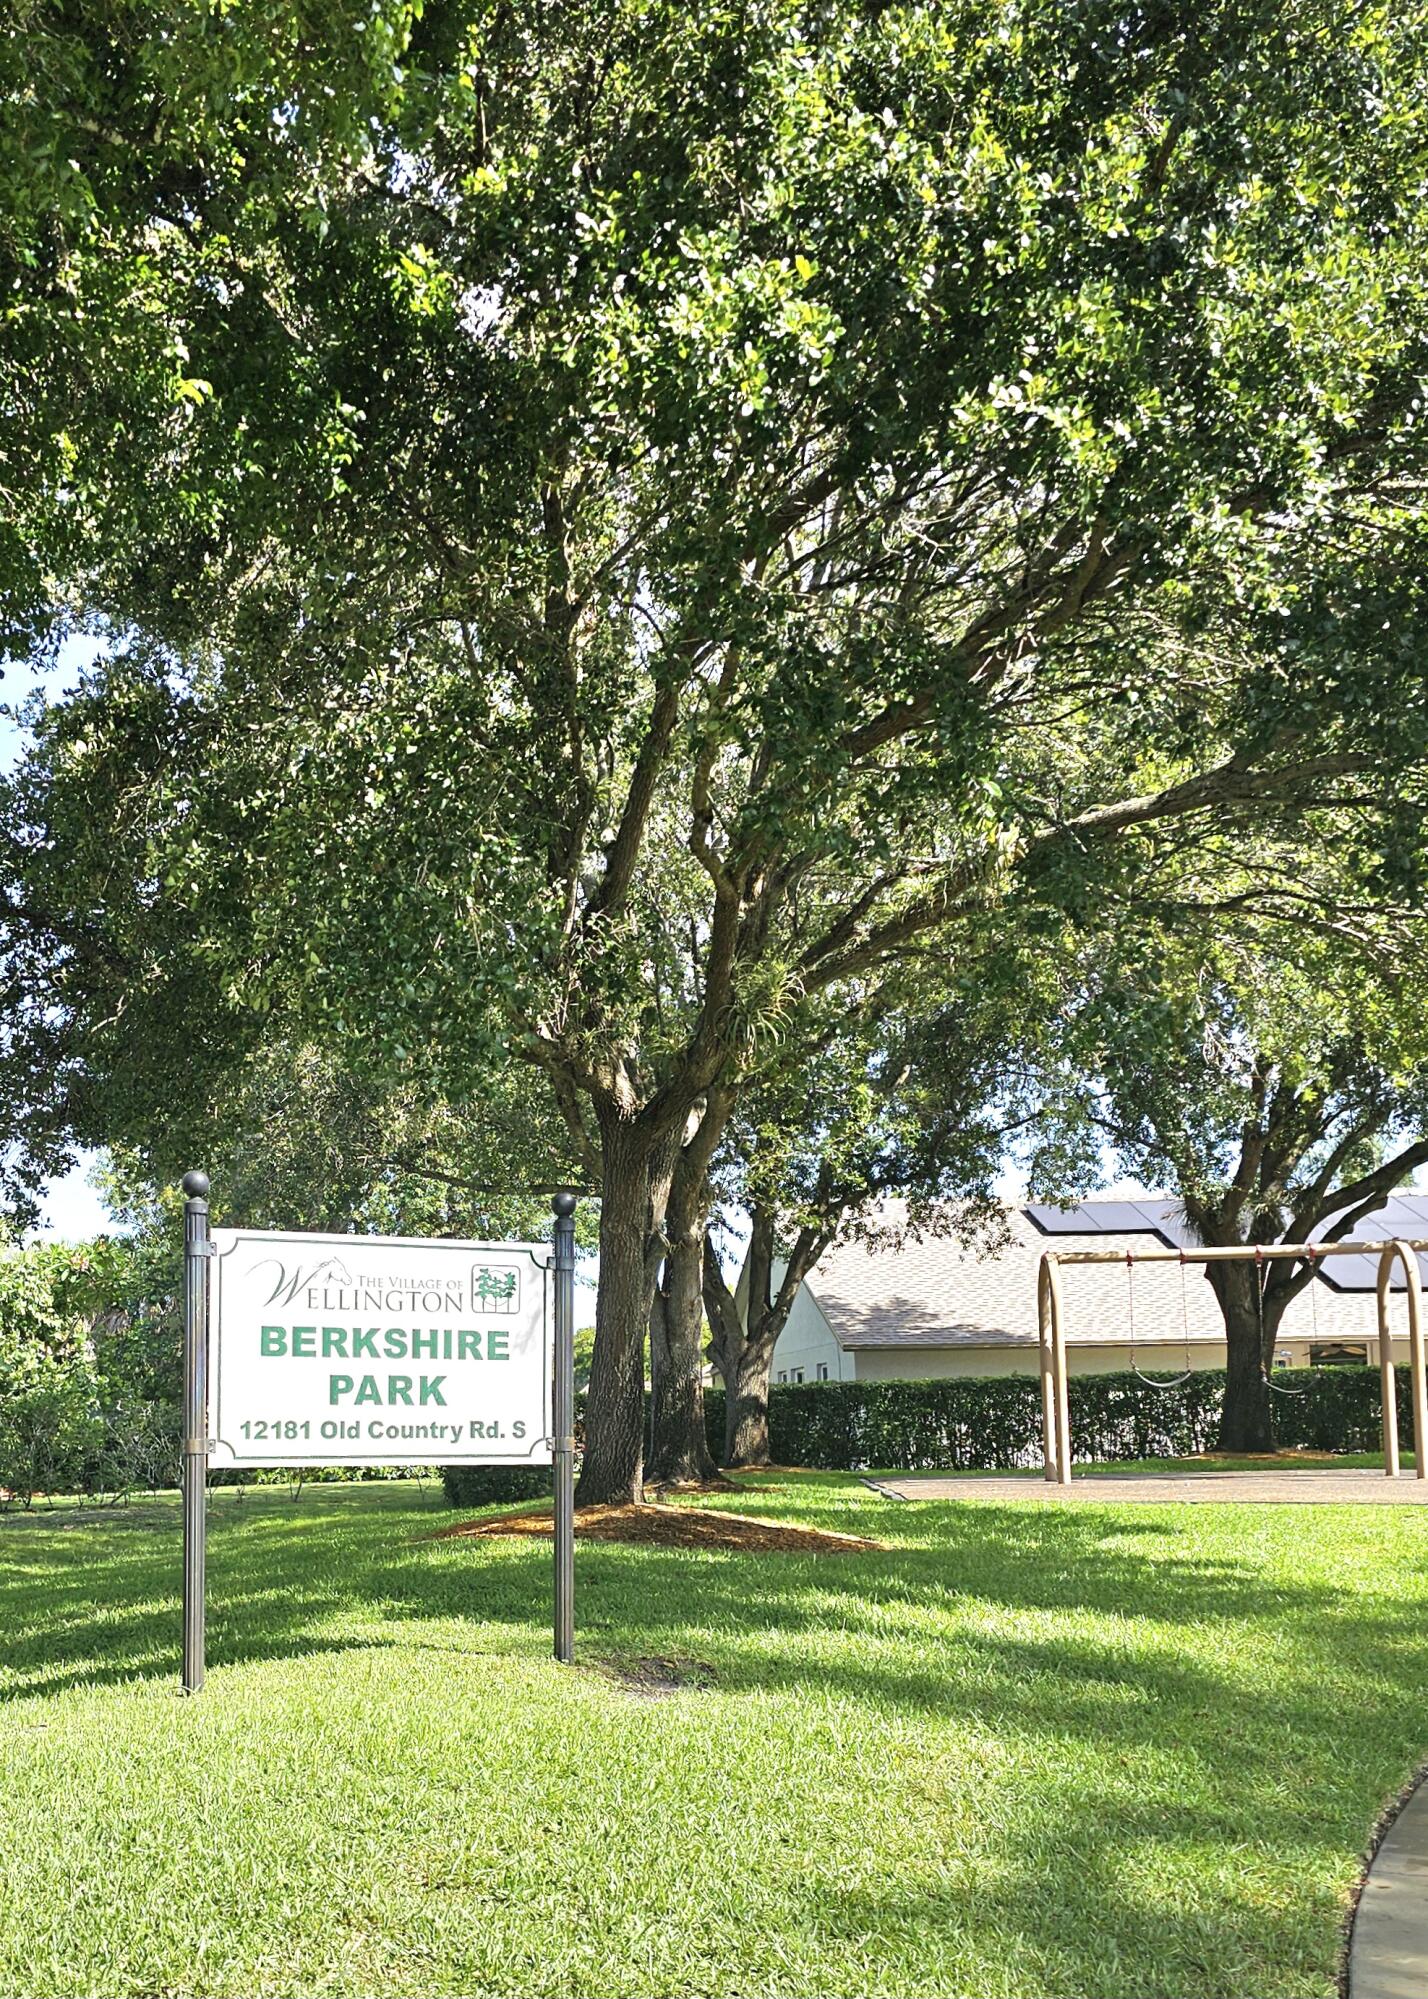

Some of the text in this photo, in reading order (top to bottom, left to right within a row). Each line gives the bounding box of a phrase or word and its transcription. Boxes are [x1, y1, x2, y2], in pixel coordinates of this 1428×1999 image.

[246, 1259, 463, 1313] WELLINGTON
[260, 1325, 510, 1361] BERKSHIRE
[329, 1374, 448, 1406] PARK
[240, 1420, 526, 1444] 12181 Old Country Rd. S
